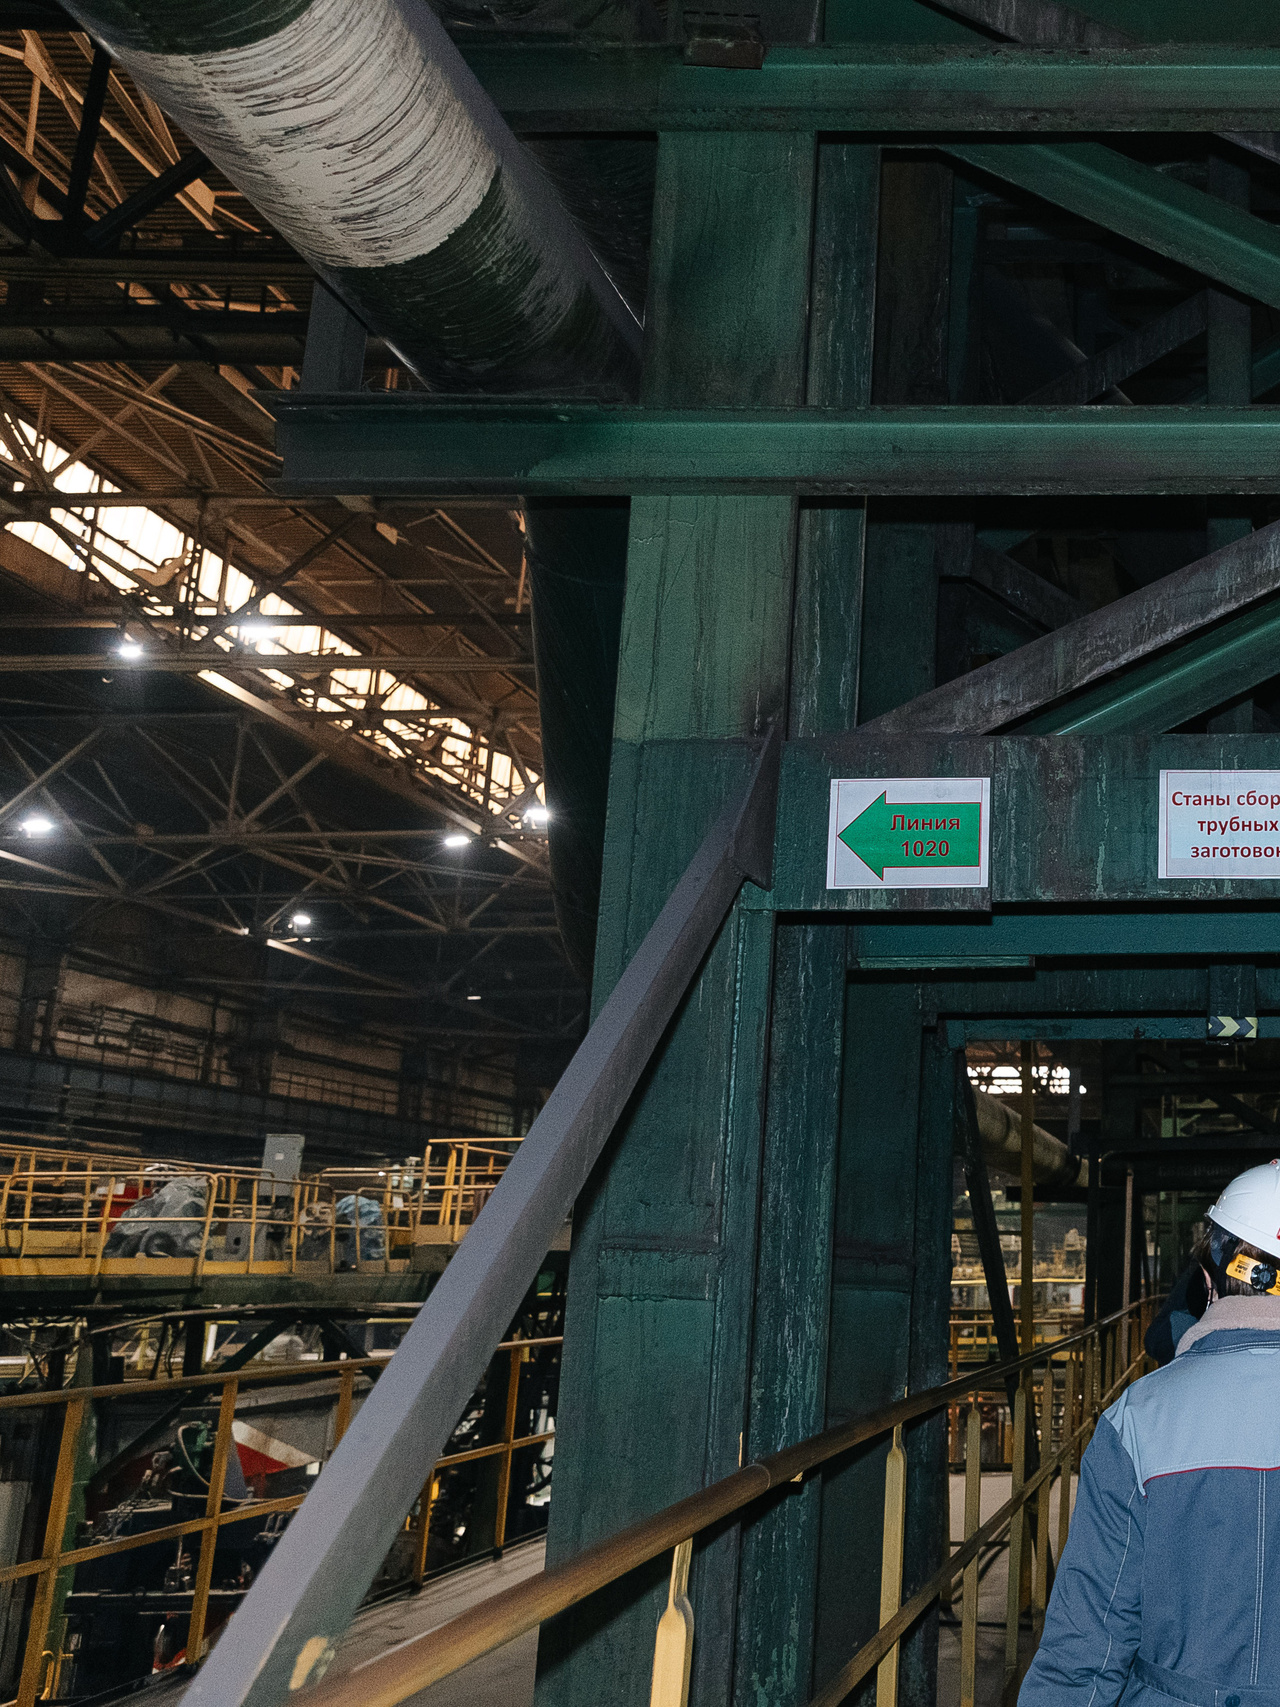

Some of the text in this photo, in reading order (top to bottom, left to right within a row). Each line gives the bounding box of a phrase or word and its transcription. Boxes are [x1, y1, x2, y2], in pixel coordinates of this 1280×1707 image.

[1171, 791, 1230, 806] Станы
[890, 814, 961, 831] Линия
[1197, 816, 1279, 835] трубных
[901, 840, 950, 857] 1020
